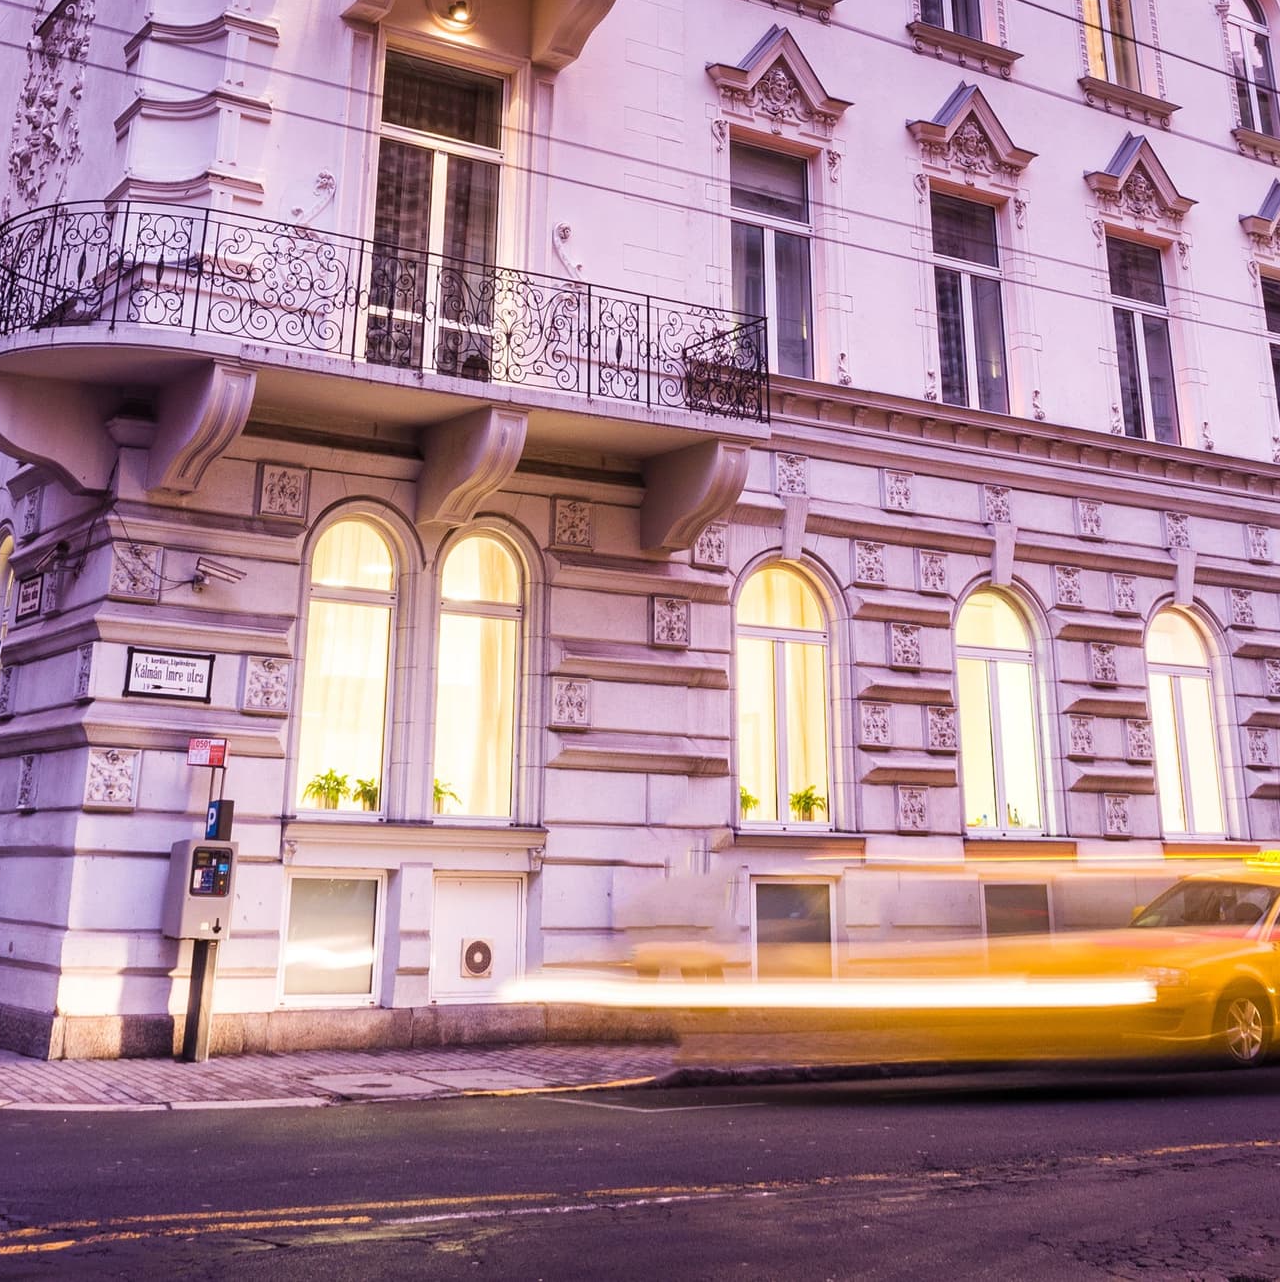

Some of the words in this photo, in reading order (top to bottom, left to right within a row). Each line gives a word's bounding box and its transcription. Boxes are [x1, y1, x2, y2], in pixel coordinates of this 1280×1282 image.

[134, 663, 162, 679] Kálmán
[165, 666, 183, 681] Imre
[186, 669, 204, 684] utca
[207, 808, 216, 832] P
